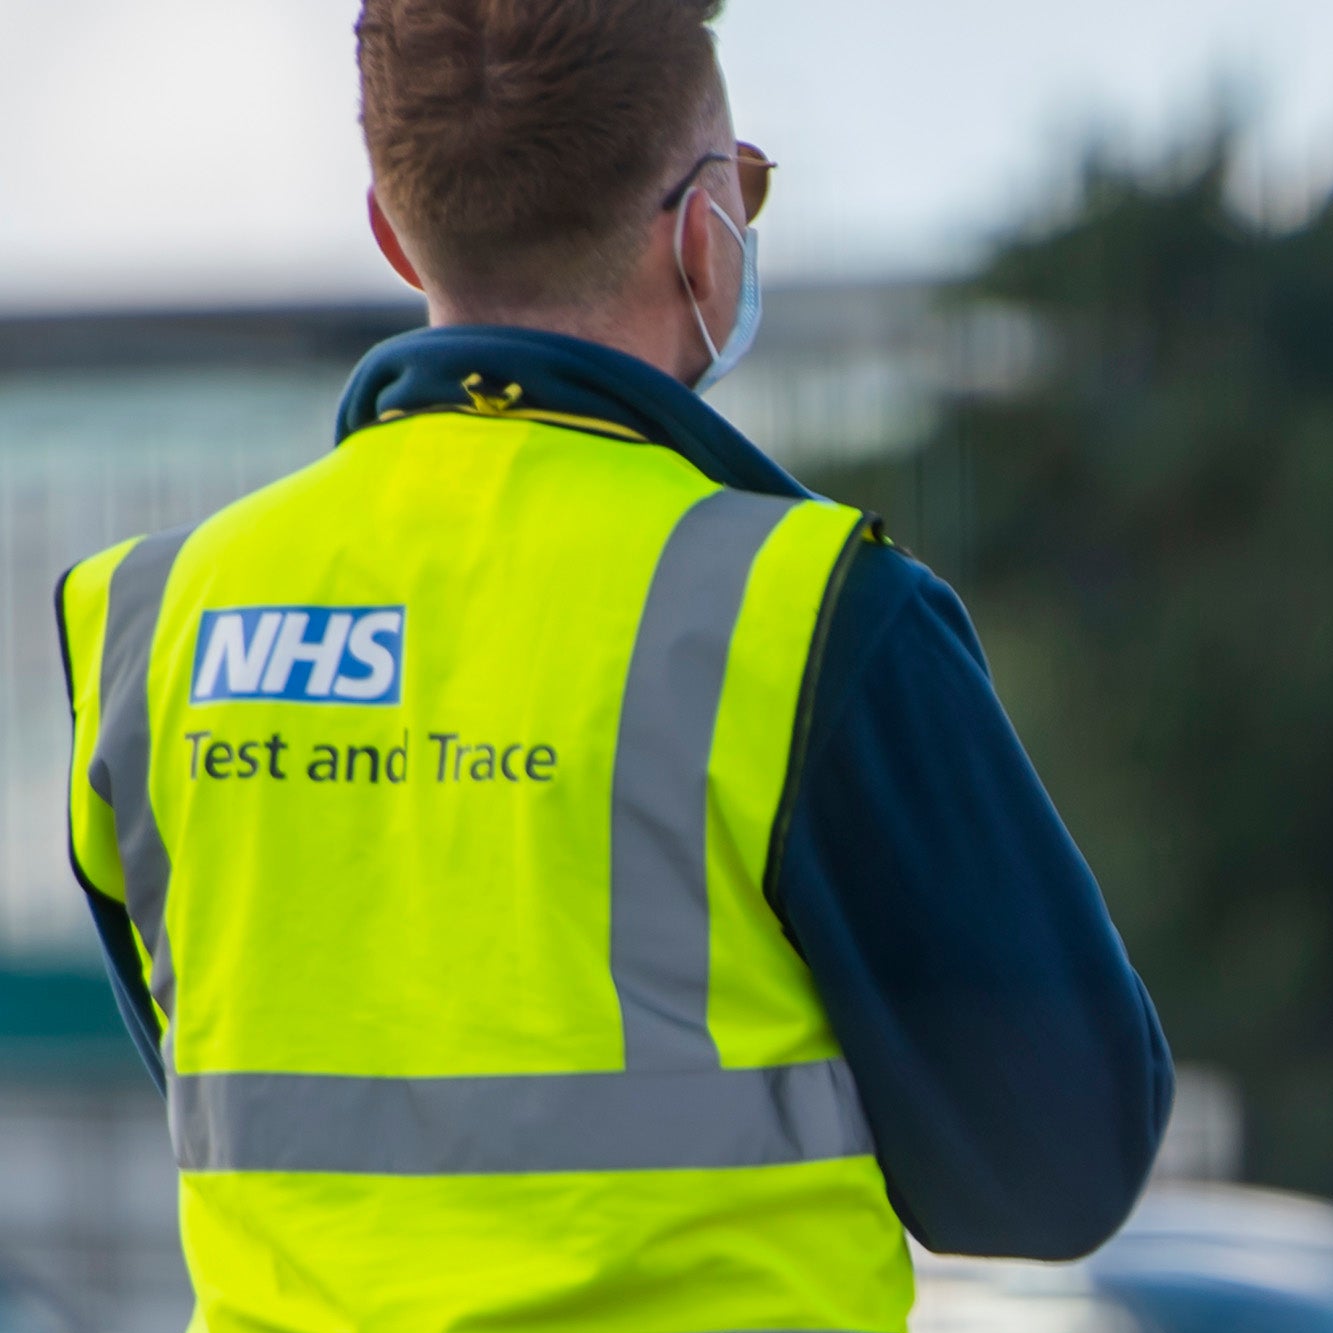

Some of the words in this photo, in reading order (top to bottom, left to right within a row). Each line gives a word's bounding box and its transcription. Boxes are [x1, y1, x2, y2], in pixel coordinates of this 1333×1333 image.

[194, 611, 402, 697] NHS
[184, 730, 288, 781] Test
[306, 727, 409, 784] and
[427, 732, 558, 783] Trace
